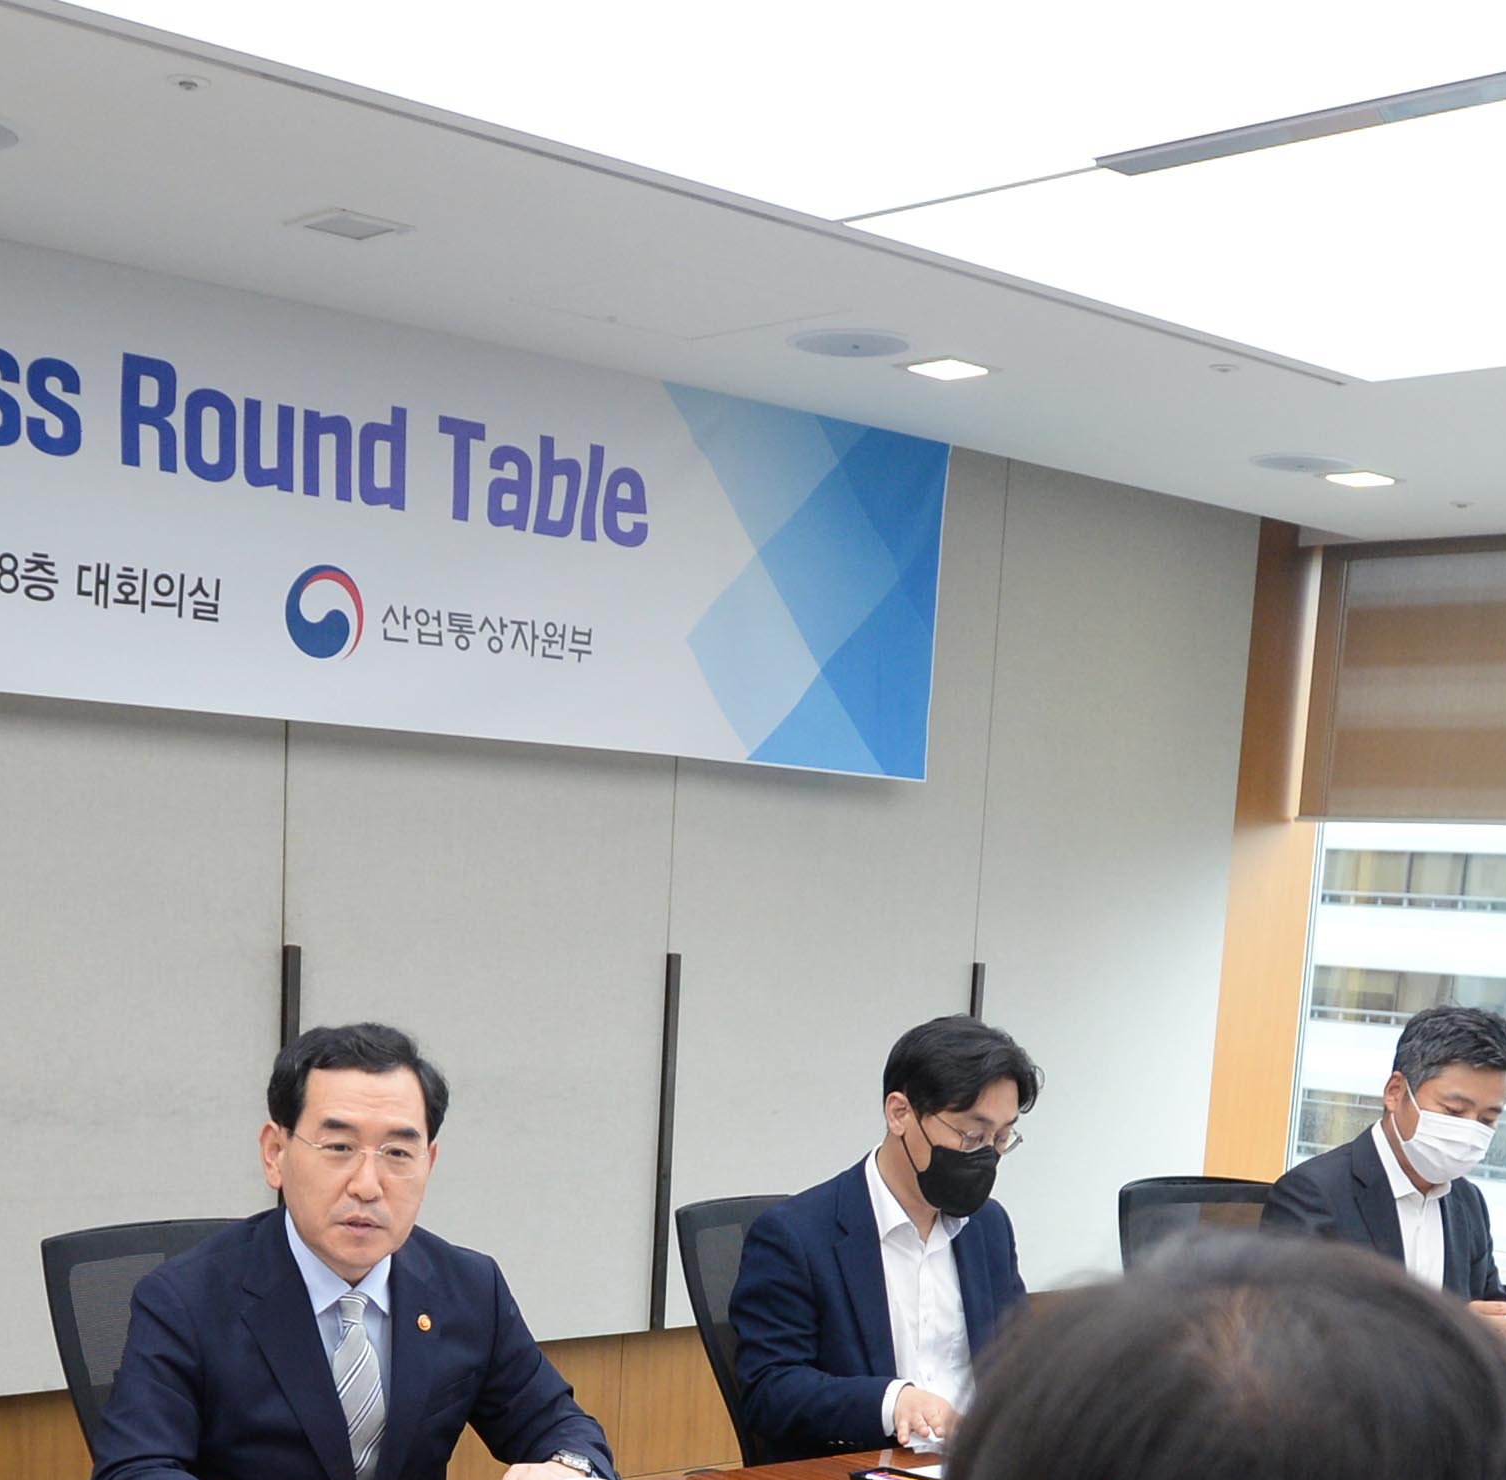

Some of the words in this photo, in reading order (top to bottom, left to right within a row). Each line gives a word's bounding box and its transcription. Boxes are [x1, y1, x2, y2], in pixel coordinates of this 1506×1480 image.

[120, 352, 407, 511] Round
[438, 414, 649, 548] Table
[75, 562, 222, 623] 대회의실
[381, 604, 593, 663] 산업통상자원부
